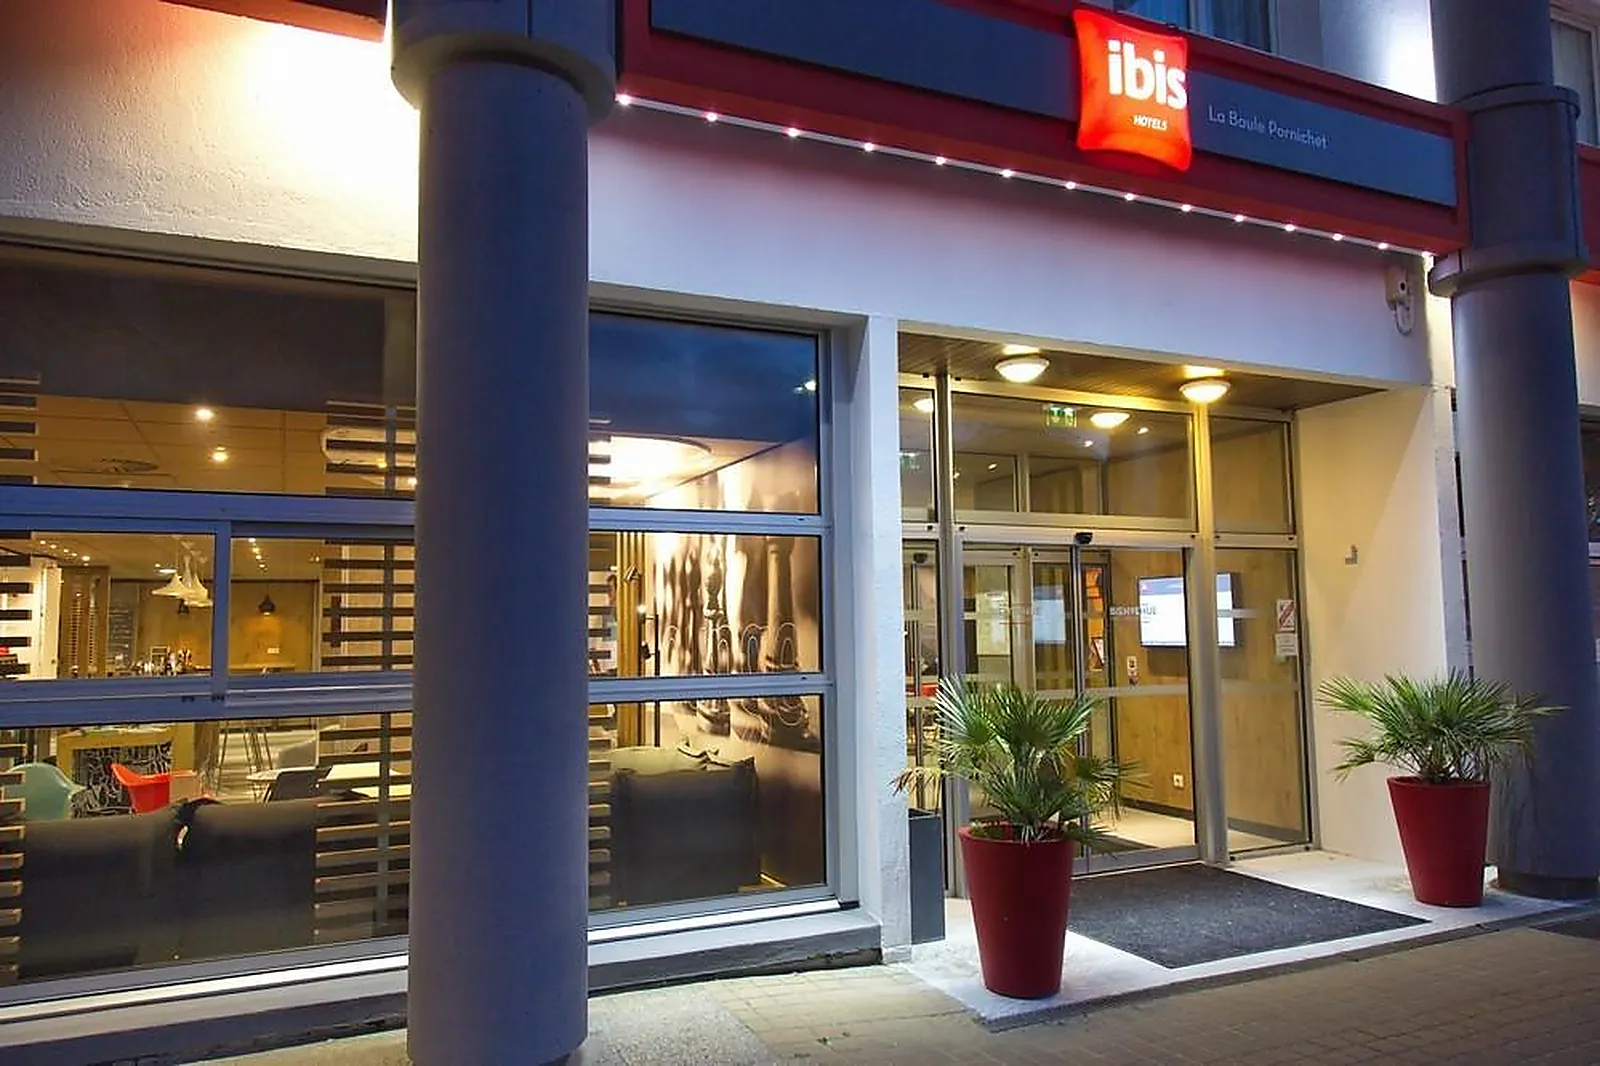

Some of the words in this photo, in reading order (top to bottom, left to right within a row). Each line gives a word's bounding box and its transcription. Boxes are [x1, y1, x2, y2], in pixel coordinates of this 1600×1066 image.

[1108, 39, 1187, 110] ibis
[1133, 114, 1167, 130] HOTELS
[1208, 104, 1225, 123] La
[1229, 110, 1265, 133] Baule
[1268, 120, 1327, 149] Pornichet
